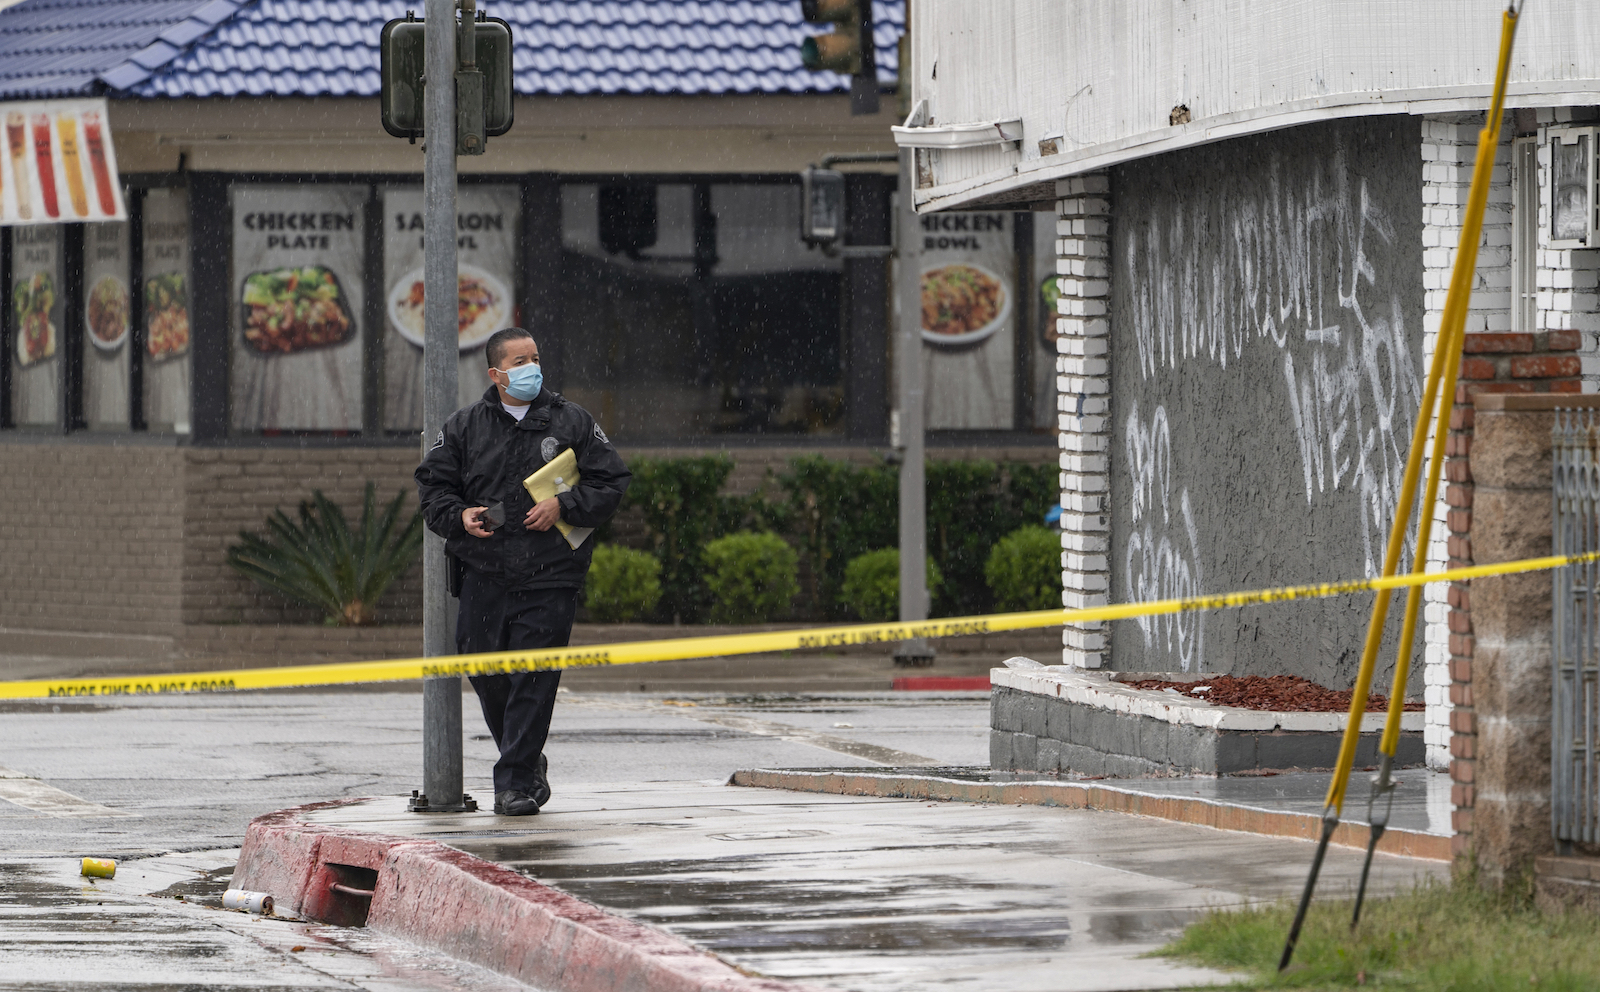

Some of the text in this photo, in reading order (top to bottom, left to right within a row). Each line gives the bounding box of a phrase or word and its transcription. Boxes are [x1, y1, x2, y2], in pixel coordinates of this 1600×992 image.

[243, 212, 355, 231] CHICKEN
[395, 212, 503, 231] SAON
[921, 213, 1003, 231] HICKEN
[267, 235, 330, 250] PLATE
[924, 236, 981, 250] BOWL
[422, 651, 611, 678] POLICE LINE DO NOT CROSS
